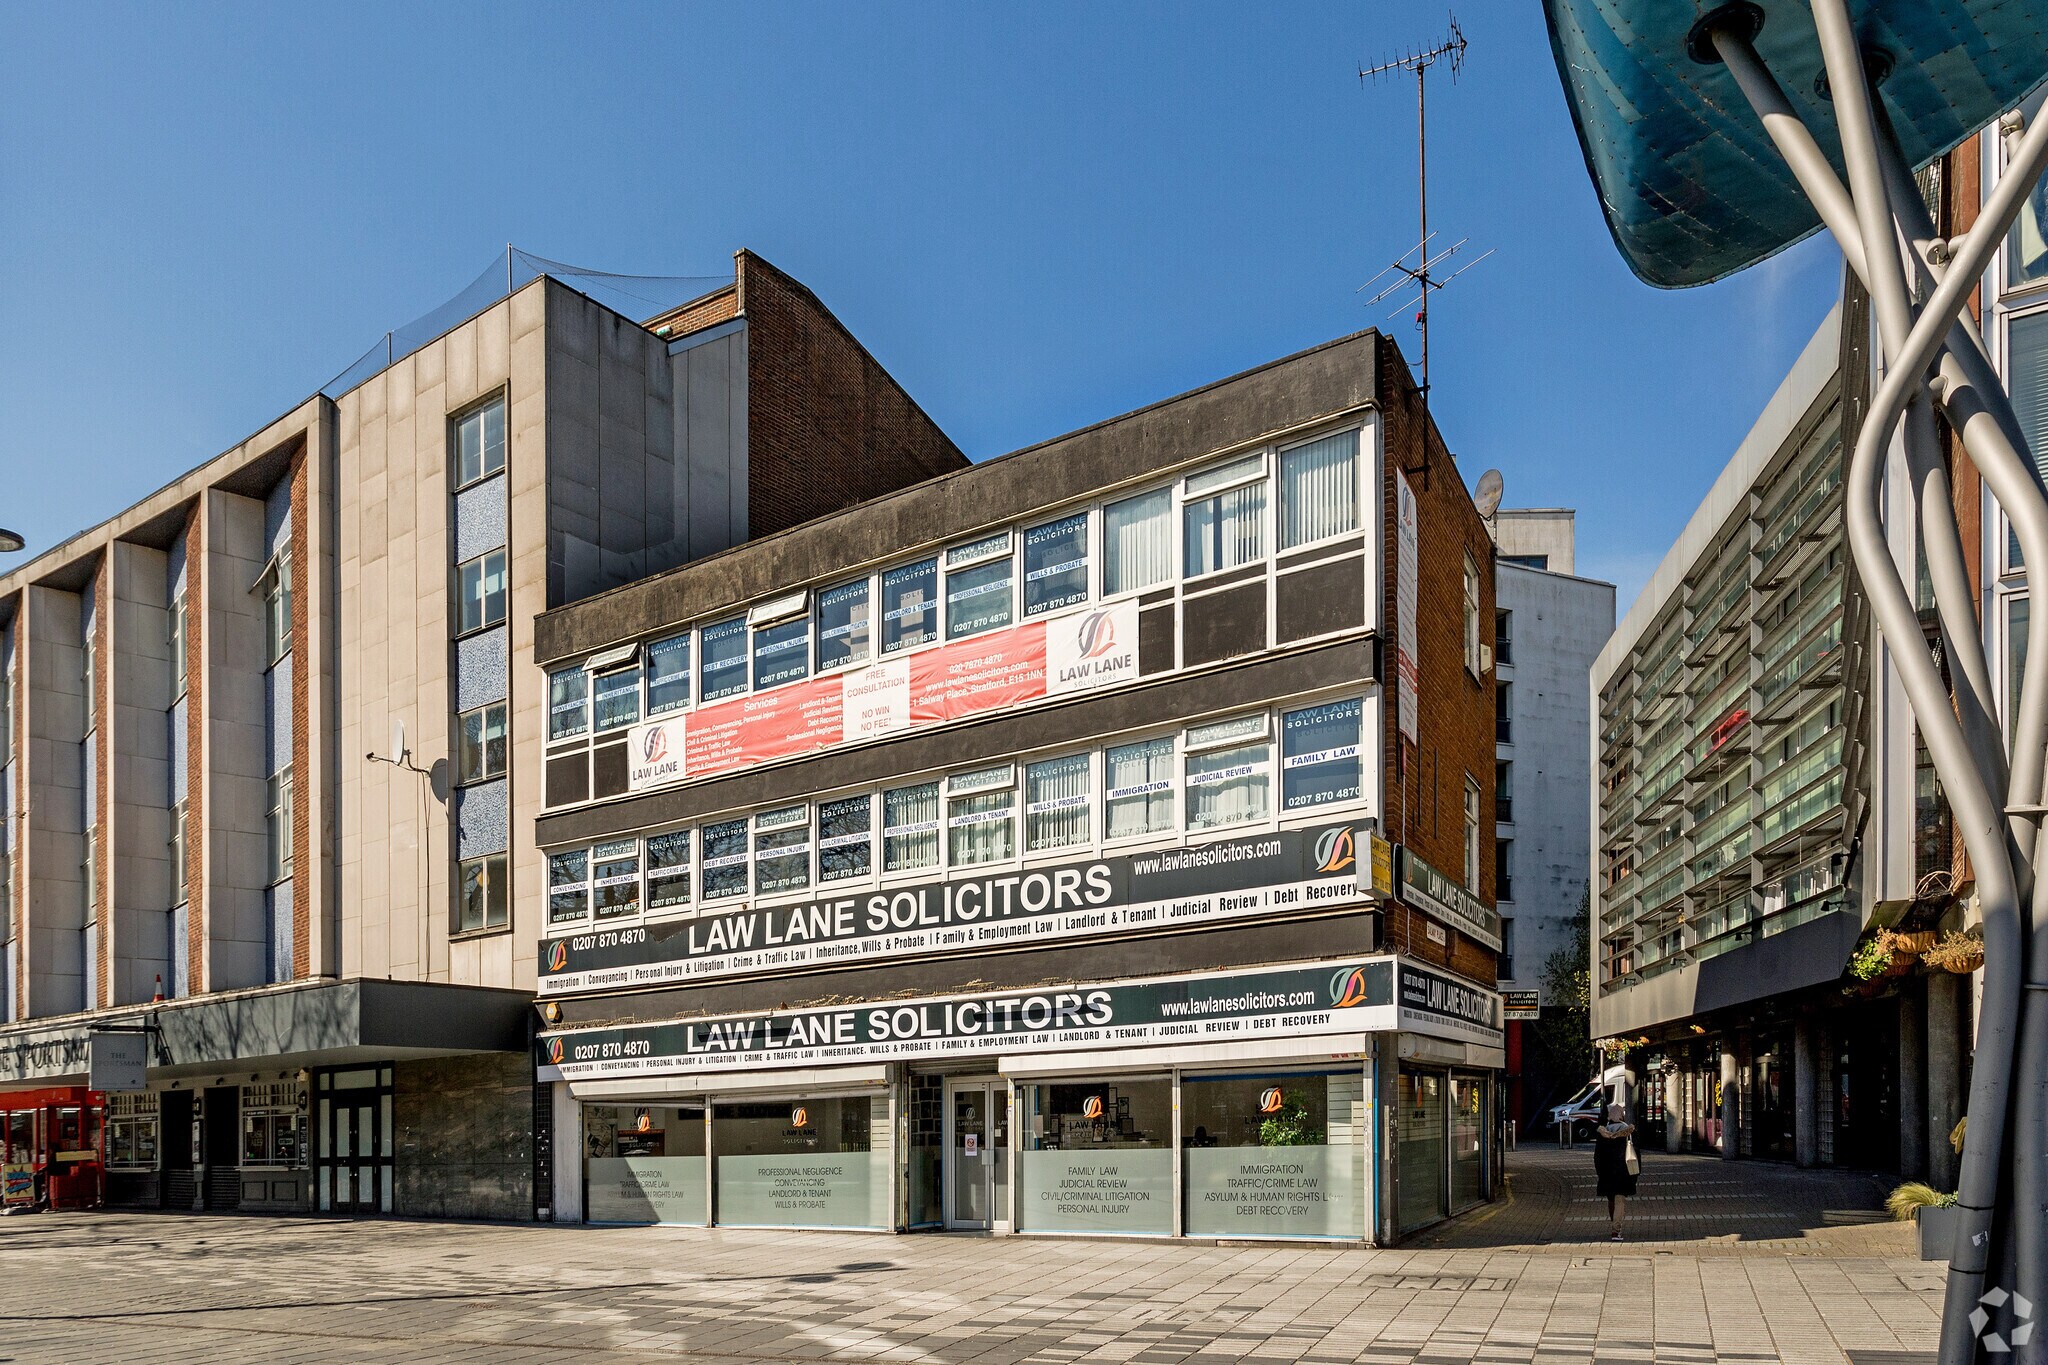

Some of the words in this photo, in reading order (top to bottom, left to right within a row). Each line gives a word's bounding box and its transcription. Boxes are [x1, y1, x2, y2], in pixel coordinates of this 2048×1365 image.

[1028, 526, 1052, 539] LAW
[1056, 516, 1086, 530] LANE
[1028, 522, 1086, 546] SOLICITORS
[1030, 568, 1048, 580] WILLS
[1055, 560, 1082, 572] PROBATE
[1028, 602, 1047, 614] 0207
[1050, 598, 1064, 608] 870
[1066, 592, 1086, 604] 4870
[949, 664, 963, 673] 020
[964, 658, 982, 670] 7870
[984, 654, 1003, 665] 4870
[1060, 663, 1090, 682] LAW
[1095, 654, 1131, 674] LANE
[866, 668, 886, 681] FREE
[926, 662, 1028, 692] www.lawlanesolicitors.com
[1074, 673, 1116, 688] SOLICITORS
[847, 677, 905, 698] CONSULTATION
[919, 693, 945, 705] Salway
[1009, 674, 1024, 685] E15
[1026, 669, 1043, 680] 1NN
[744, 697, 778, 712] Services
[862, 710, 873, 719] NO
[875, 706, 890, 716] WIN
[1288, 708, 1318, 722] LAW
[1322, 701, 1360, 716] LANE
[860, 721, 871, 732] NO
[1287, 708, 1360, 729] SOLICITORS
[1110, 746, 1172, 763] SOLICITORS
[1291, 752, 1327, 766] FAMILY
[1333, 746, 1356, 758] LAW
[633, 766, 652, 780] LAW
[655, 761, 678, 776] LANE
[1193, 771, 1224, 784] JUDICIAL
[1225, 766, 1252, 780] REVIEW
[1112, 780, 1169, 798] IMMIGRATION
[1288, 794, 1313, 807] 0207
[1315, 791, 1334, 804] 870
[1336, 787, 1361, 800] 4870
[760, 847, 785, 858] PERSONAL
[787, 845, 806, 854] INJURY
[1134, 839, 1281, 876] www.lawlanesolicitors.com
[601, 875, 634, 885] INHERITANCE
[1428, 870, 1441, 899] LAW
[1442, 880, 1457, 910] LANE
[1457, 890, 1486, 927] SOLICITORS
[688, 913, 756, 955] LAW
[765, 900, 855, 945] LANE
[866, 864, 1112, 932] SOLICITORS
[546, 976, 580, 990] Immigration
[588, 971, 628, 985] Conveyancing
[664, 964, 682, 978] Injury
[686, 963, 690, 973] &
[694, 959, 724, 973] Litigation
[734, 954, 753, 968] Crime
[757, 954, 762, 965] &
[765, 952, 788, 964] Traffic
[791, 949, 806, 961] Law
[816, 944, 860, 958] Inheritance,
[862, 939, 881, 953] Wills
[886, 939, 891, 950] &
[894, 934, 924, 949] Probate
[968, 929, 974, 940] &
[979, 922, 1030, 940] Employment
[1035, 921, 1052, 933] Law
[1066, 912, 1106, 929] Landlord
[1112, 912, 1118, 924] &
[1170, 900, 1211, 917] Judicial
[1219, 896, 1258, 911] Review
[1274, 888, 1298, 904] Debt
[1306, 882, 1358, 900] Recovery
[572, 935, 596, 951] 0207
[599, 933, 617, 948] 870
[620, 928, 646, 945] 4870
[1161, 990, 1315, 1017] www.lawlanesolicitors.com
[1427, 978, 1442, 1009] LAW
[1442, 983, 1459, 1014] LANE
[1460, 989, 1491, 1024] SOLICITORS
[687, 1021, 756, 1053] LAW
[764, 1013, 856, 1049] LANE
[868, 991, 1113, 1041] SOLICITORS
[561, 1065, 593, 1073] IMMIGRATION
[601, 1061, 639, 1071] CONVEYANCING
[646, 1059, 673, 1068] PERSONAL
[675, 1057, 695, 1066] INJURY
[706, 1055, 736, 1064] LITIGATION
[745, 1053, 762, 1062] CRIME
[773, 1052, 798, 1060] TRAFFIC
[801, 1050, 814, 1059] LAW
[870, 1045, 890, 1054] WILLS
[893, 1044, 898, 1052] &
[901, 1042, 931, 1051] PROBATE
[942, 1039, 967, 1049] FAMILY
[970, 1039, 976, 1048] &
[978, 1036, 1028, 1046] EMPLOYMENT
[1033, 1034, 1049, 1043] LAW
[1059, 1031, 1099, 1041] LANDLORD
[1106, 1030, 1111, 1039] &
[1115, 1027, 1147, 1038] TENANT
[1159, 1024, 1198, 1036] JUDICIAL
[1206, 1021, 1240, 1032] REVIEW
[1253, 1018, 1276, 1029] DEBT
[1282, 1014, 1330, 1027] RECOVERY
[575, 1044, 600, 1060] 0207
[602, 1042, 622, 1058] 870
[624, 1040, 650, 1055] 4870
[758, 1168, 801, 1176] PROFESSIONAL
[803, 1167, 842, 1175] NEGLIGENCE
[1068, 1167, 1096, 1176] FAMILY
[1100, 1167, 1118, 1175] LAW
[1240, 1164, 1303, 1174] IMMIGRATION
[775, 1178, 825, 1186] CONVEYANCING
[1059, 1180, 1095, 1188] JUDICIAL
[1097, 1179, 1127, 1188] REVIEW
[1227, 1178, 1294, 1189] TRAFFIC/CRIME
[1298, 1178, 1318, 1188] LAW
[1041, 1192, 1102, 1202] CIVIL/CRIMINAL
[1105, 1192, 1150, 1201] LITIGATION
[1204, 1192, 1238, 1202] ASYLUM
[1241, 1192, 1248, 1201] &
[1250, 1192, 1284, 1201] HUMAN
[1287, 1192, 1320, 1201] RIGHTS
[1058, 1204, 1099, 1213] PERSONAL
[1102, 1204, 1130, 1214] INJURY
[1236, 1206, 1257, 1215] DEBT
[1260, 1206, 1309, 1215] RECOVERY
